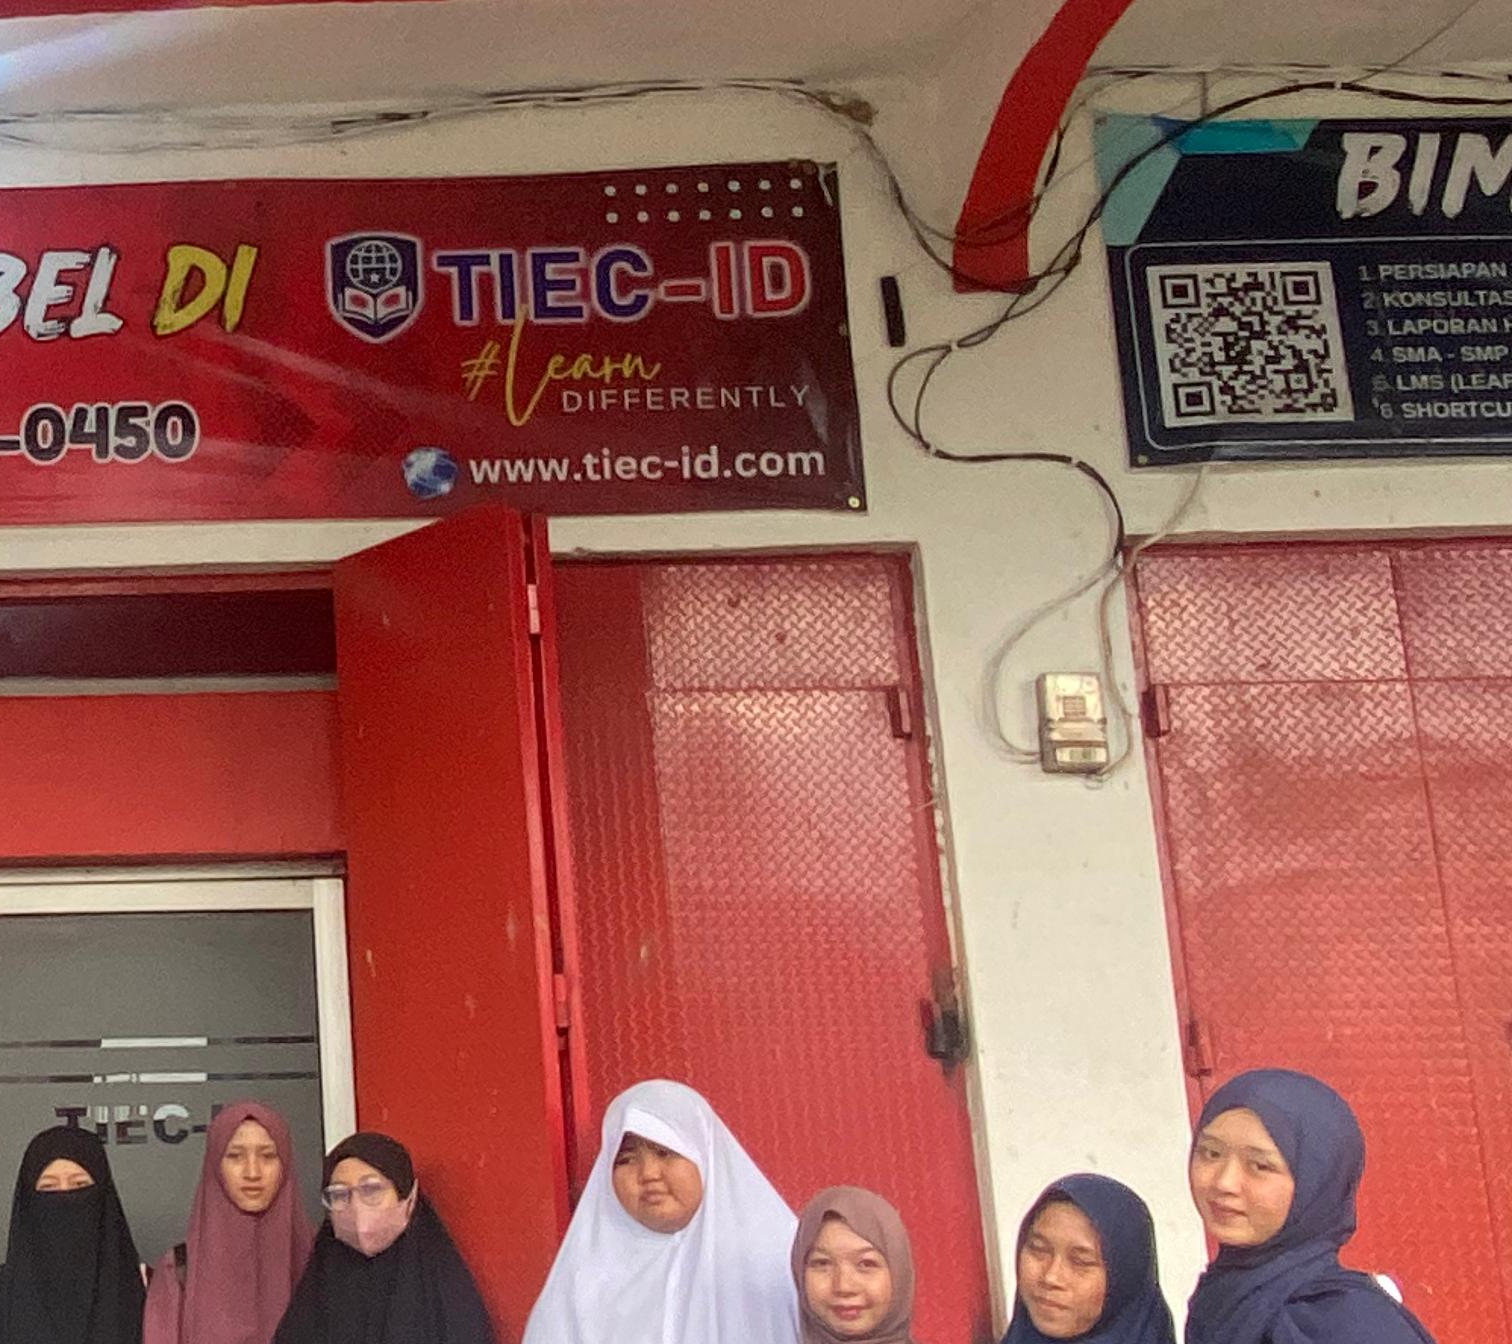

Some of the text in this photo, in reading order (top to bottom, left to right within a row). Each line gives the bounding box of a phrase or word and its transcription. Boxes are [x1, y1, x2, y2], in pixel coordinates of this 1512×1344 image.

[430, 238, 812, 326] TIEC-ID
[1377, 262, 1508, 282] PERSIAPAN
[150, 242, 260, 338] DI
[1387, 317, 1499, 336] LAPORAN
[1391, 345, 1444, 363] SMA
[1459, 344, 1510, 363] SMP
[1395, 373, 1445, 392] LMS
[560, 383, 812, 414] DIFFERENTLY
[469, 444, 826, 485] www.tiec-id.com
